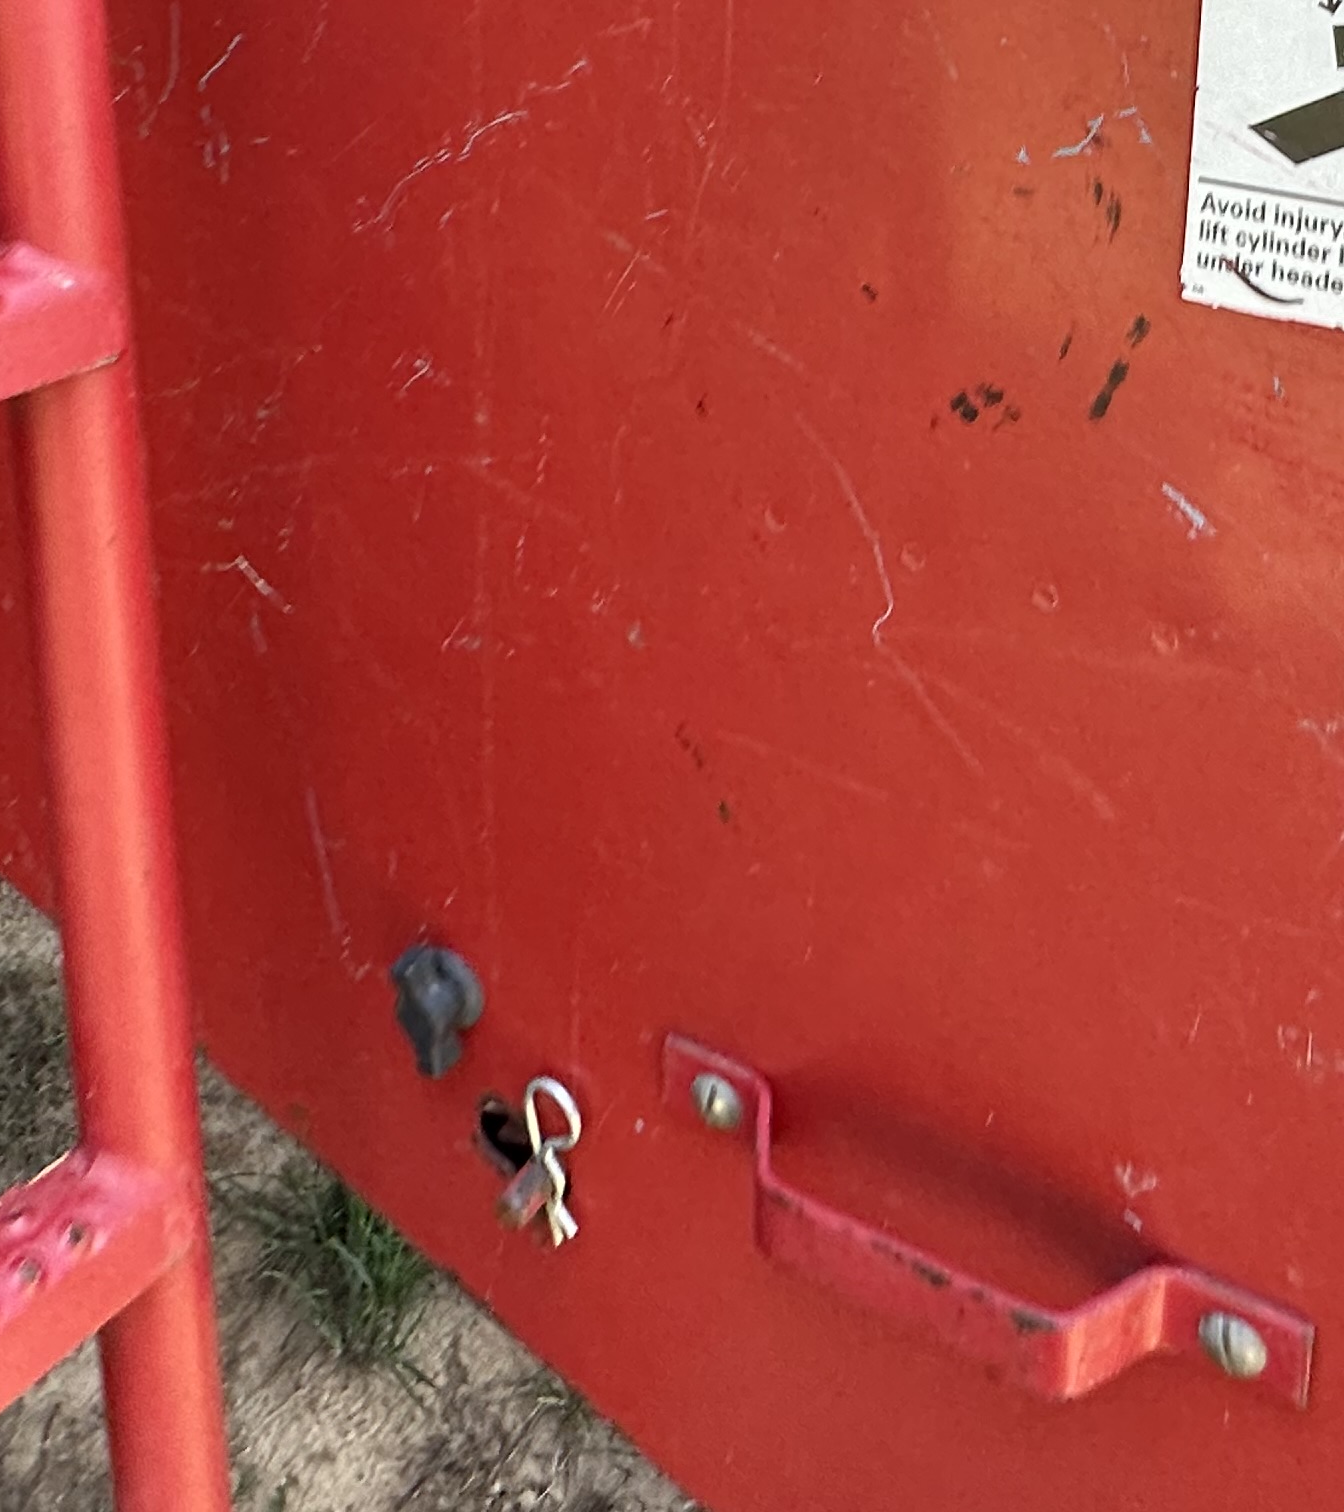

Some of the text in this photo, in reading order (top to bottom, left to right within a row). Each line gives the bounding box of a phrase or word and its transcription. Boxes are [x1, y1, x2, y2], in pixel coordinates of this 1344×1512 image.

[1200, 191, 1267, 223] Avoid
[1198, 219, 1228, 245] lift
[1236, 229, 1332, 264] cylinder
